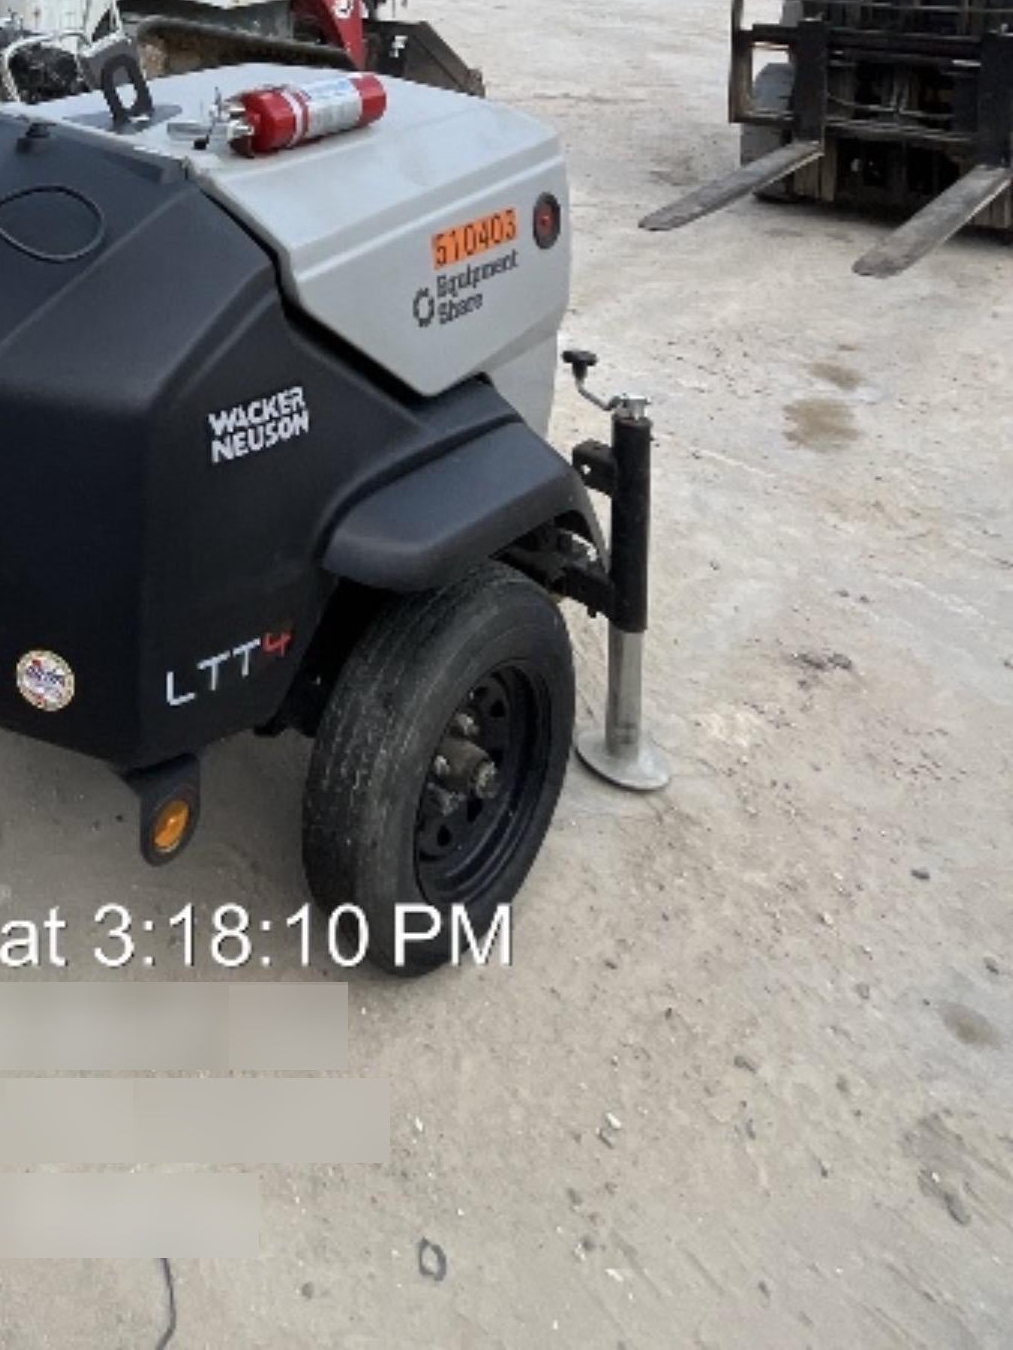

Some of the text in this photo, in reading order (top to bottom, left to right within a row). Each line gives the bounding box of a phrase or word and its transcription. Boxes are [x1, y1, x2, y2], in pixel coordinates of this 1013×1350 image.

[435, 209, 516, 266] 510403
[436, 249, 519, 298] Equipment
[438, 293, 483, 325] Share
[208, 386, 306, 436] WACKER
[211, 410, 309, 463] NEUSON
